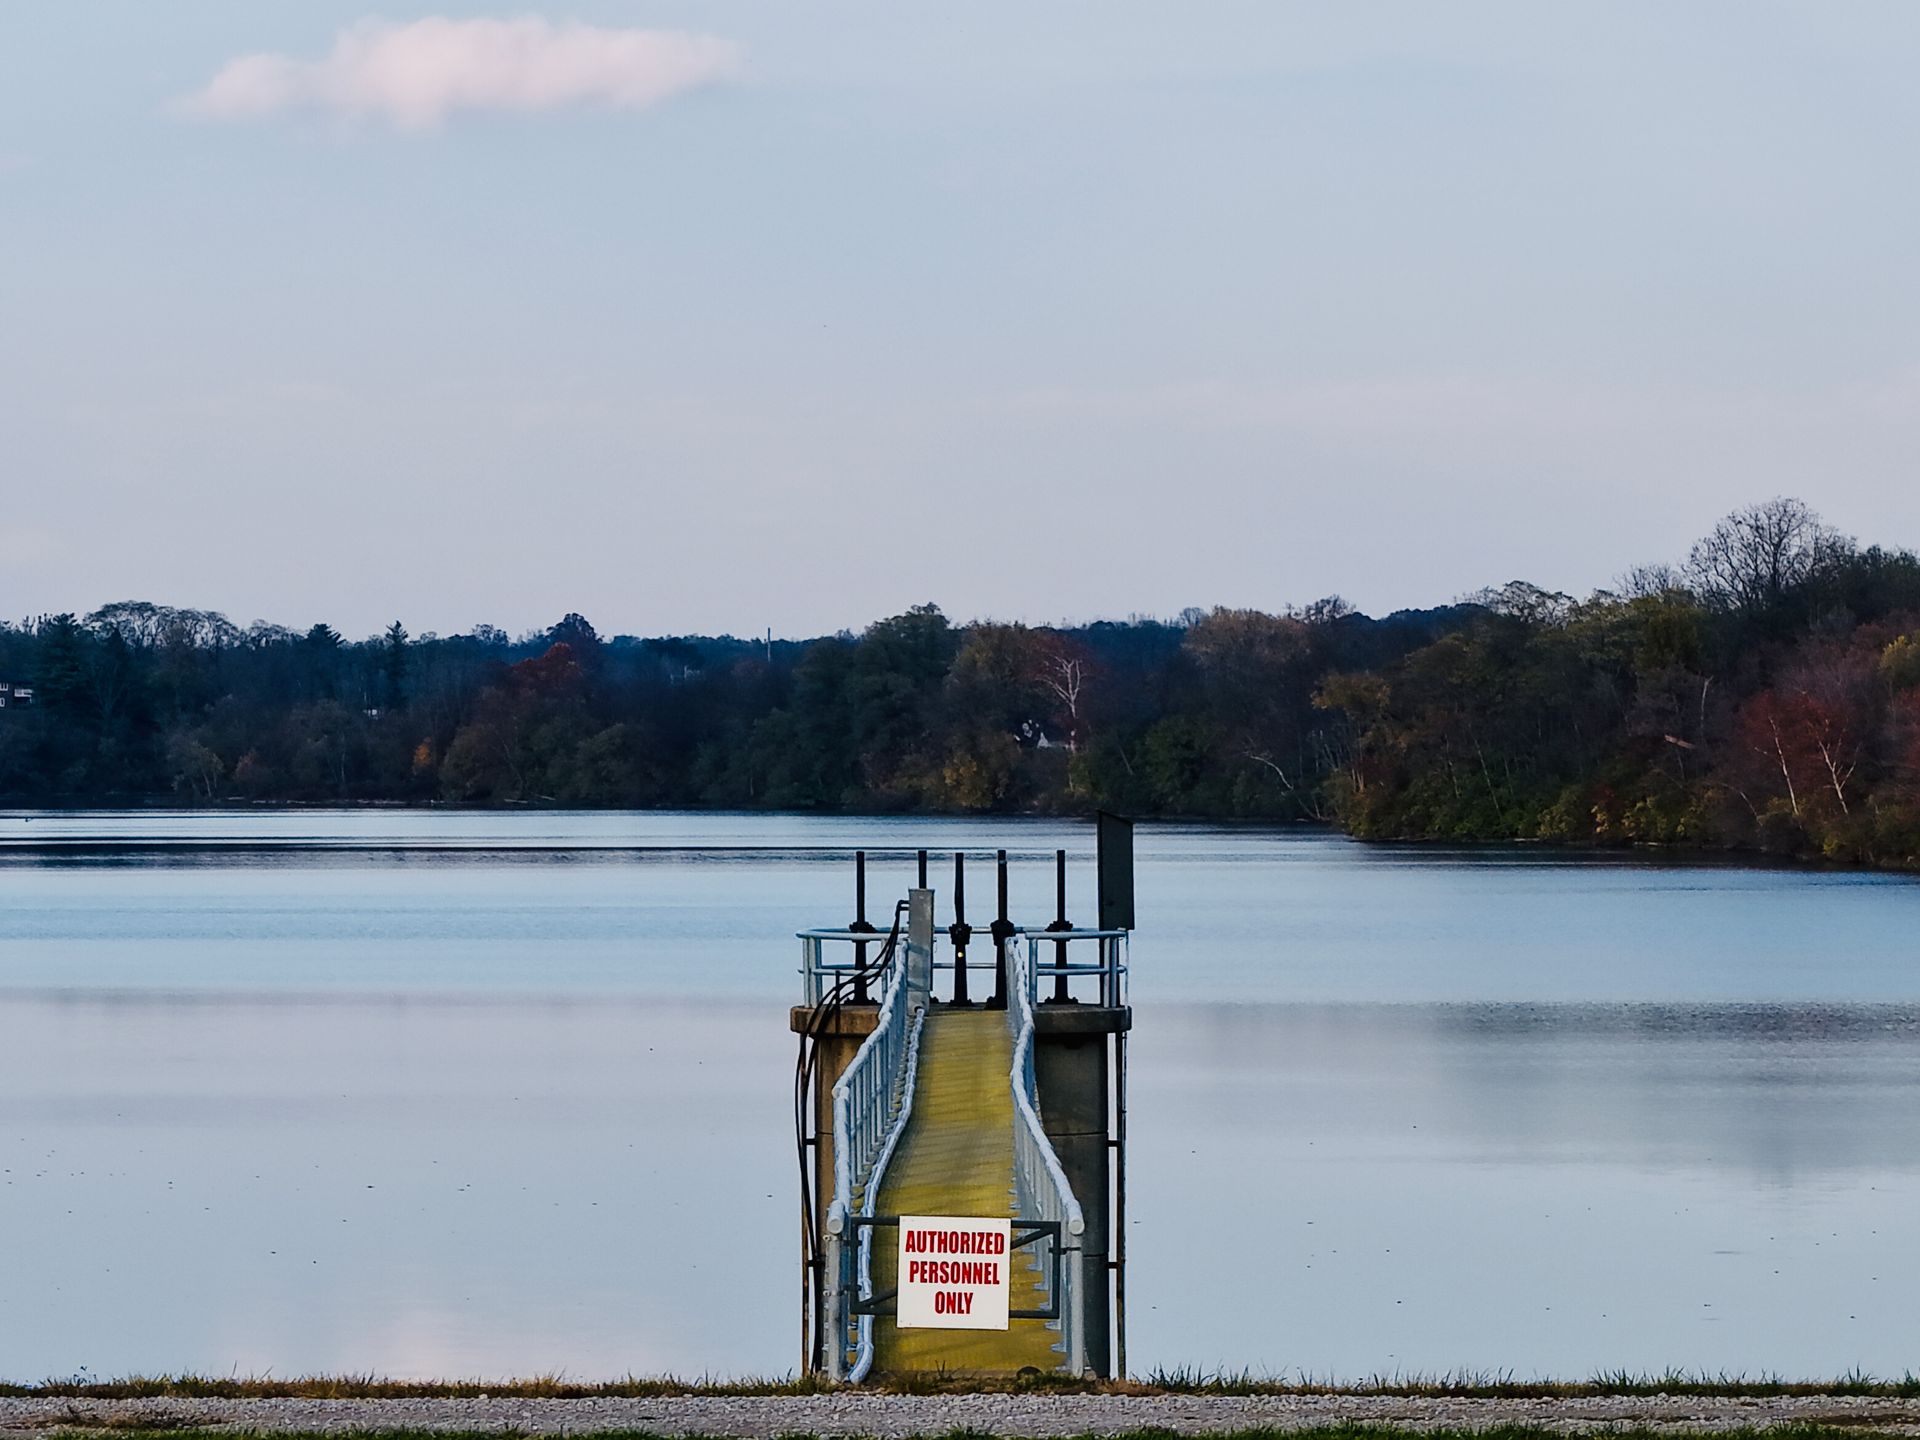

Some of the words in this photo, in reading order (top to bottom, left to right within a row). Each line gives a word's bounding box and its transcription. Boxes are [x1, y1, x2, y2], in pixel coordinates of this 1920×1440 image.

[905, 1230, 1004, 1255] AUTHORIZED
[909, 1260, 1000, 1285] PERSONNEL
[934, 1291, 974, 1314] ONLY
